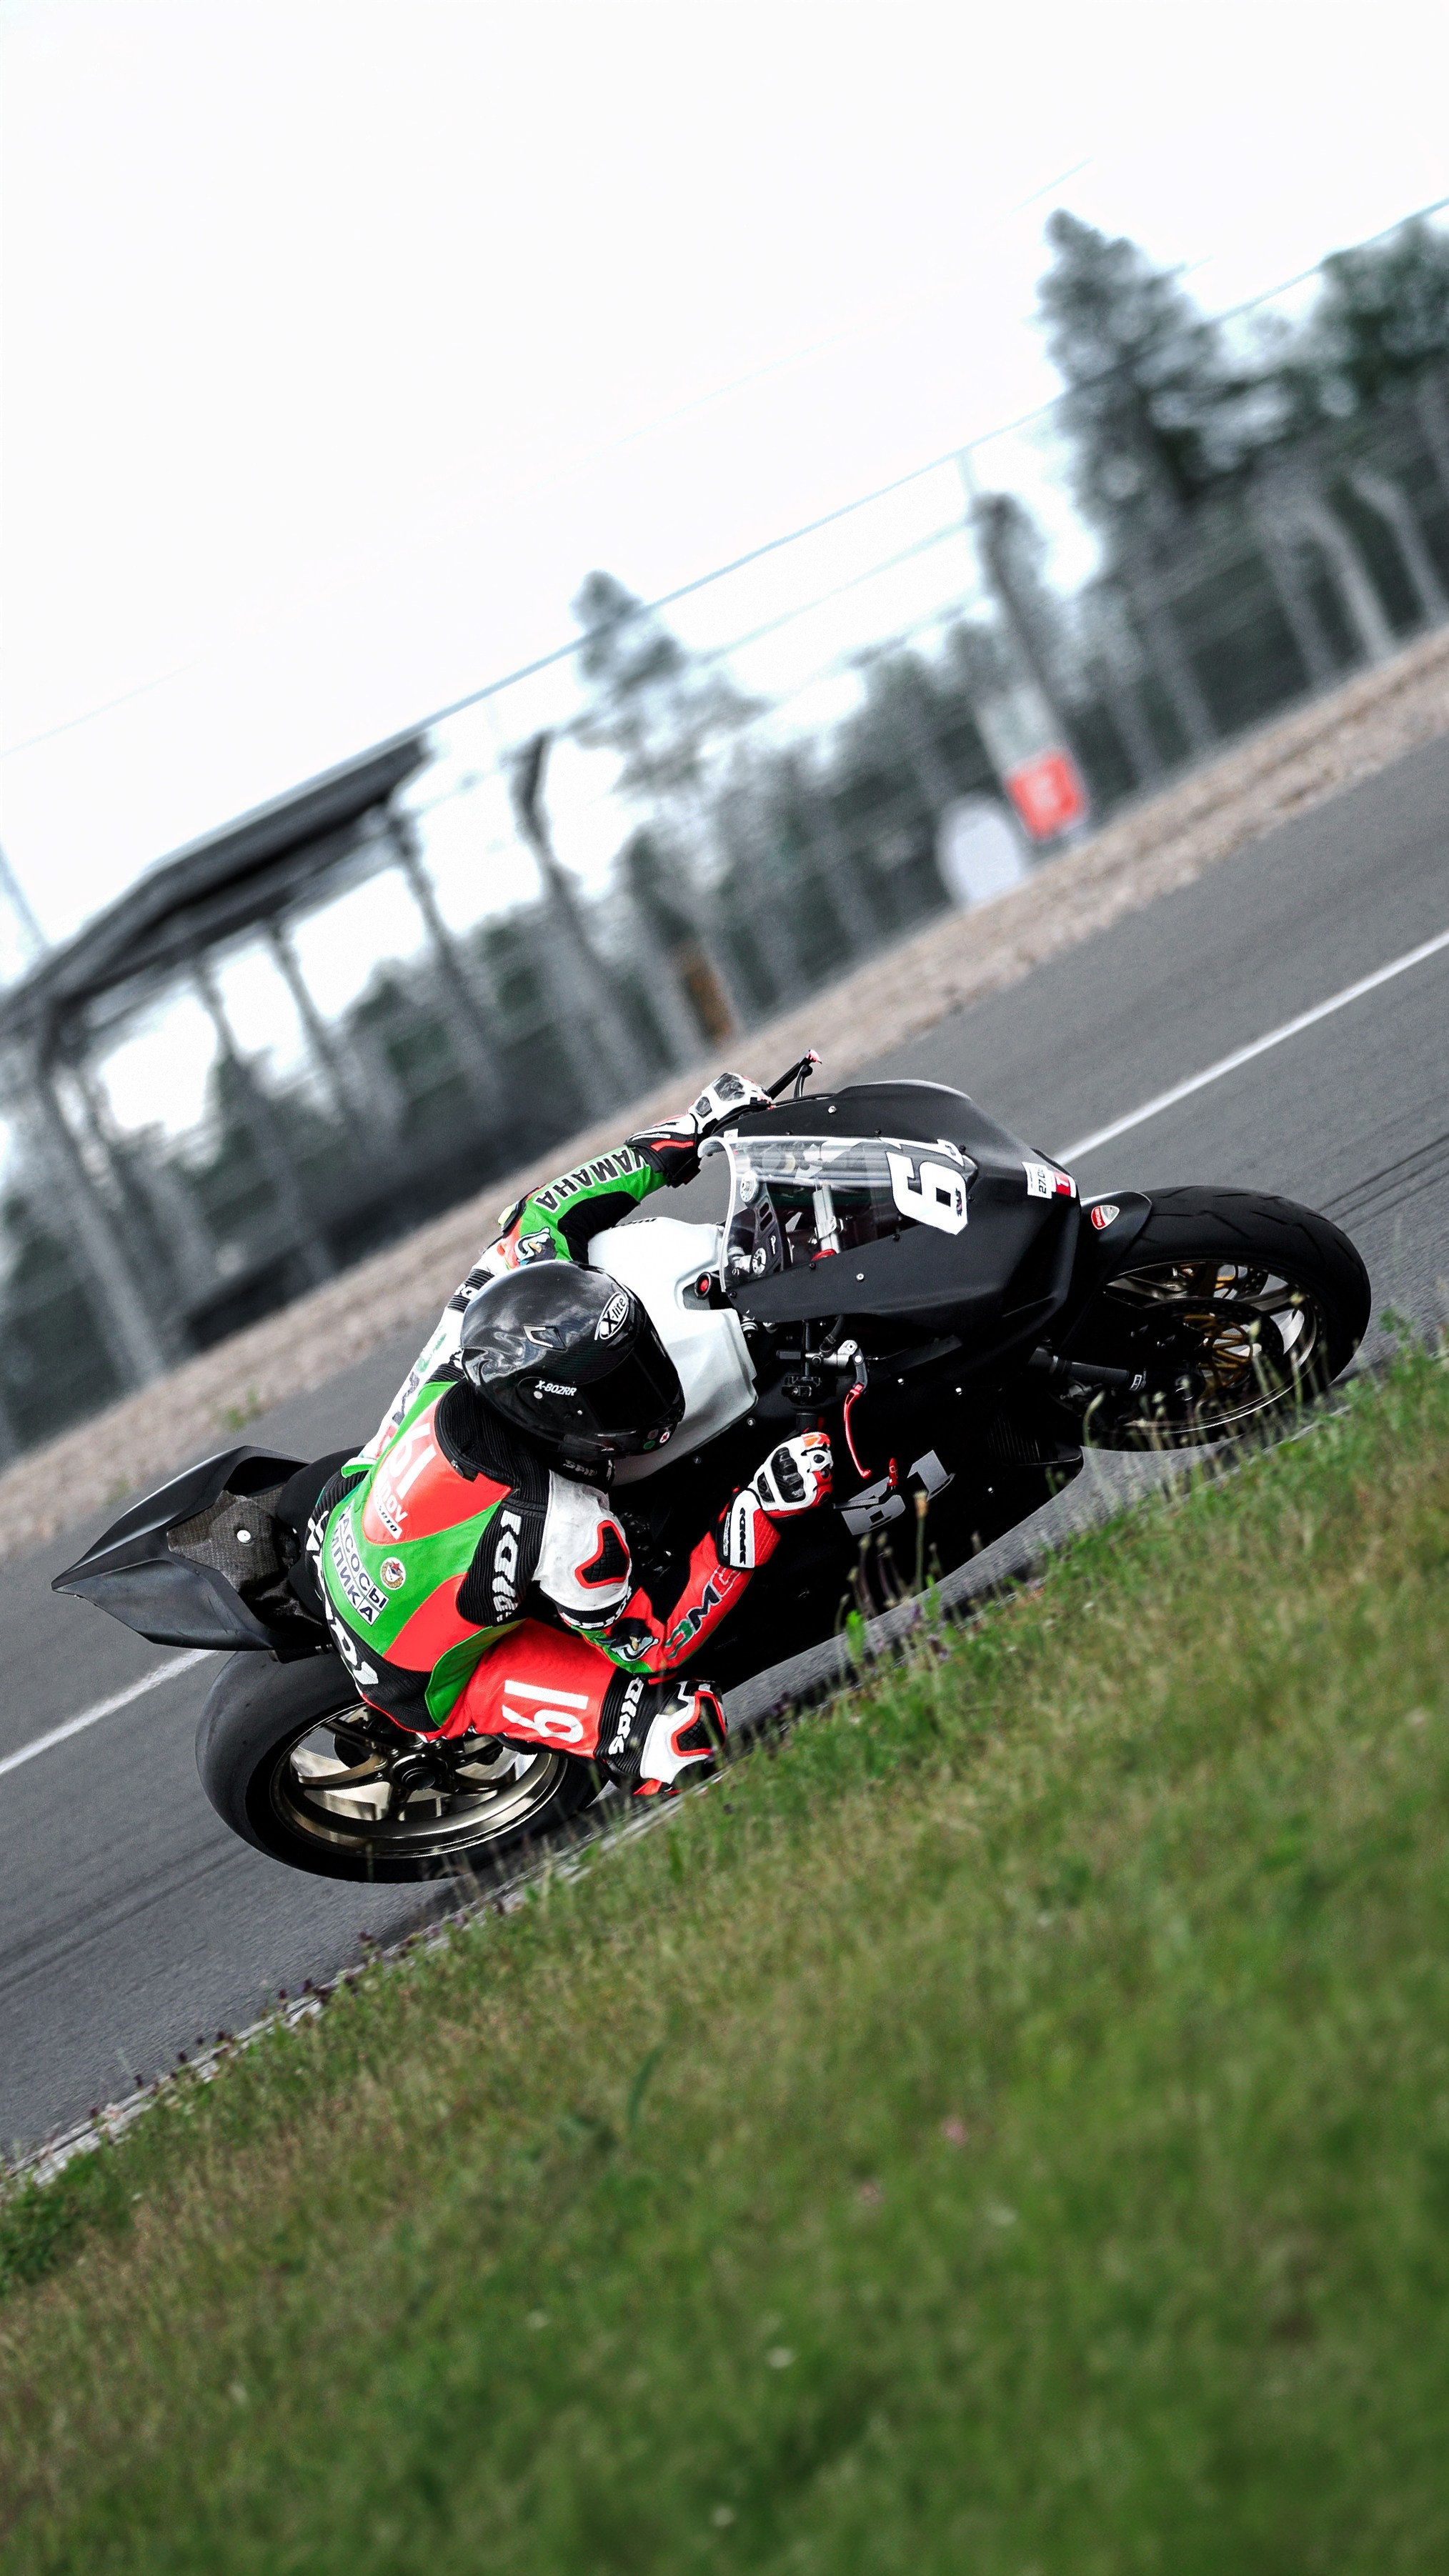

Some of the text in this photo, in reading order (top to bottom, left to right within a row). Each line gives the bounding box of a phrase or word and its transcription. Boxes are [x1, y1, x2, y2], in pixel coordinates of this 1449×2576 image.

[535, 1147, 647, 1212] YAMAHA
[601, 1297, 626, 1335] X-lite
[534, 1380, 577, 1397] X-802RR
[339, 1504, 387, 1609] АСОСЫ
[608, 1676, 644, 1755] SPID
